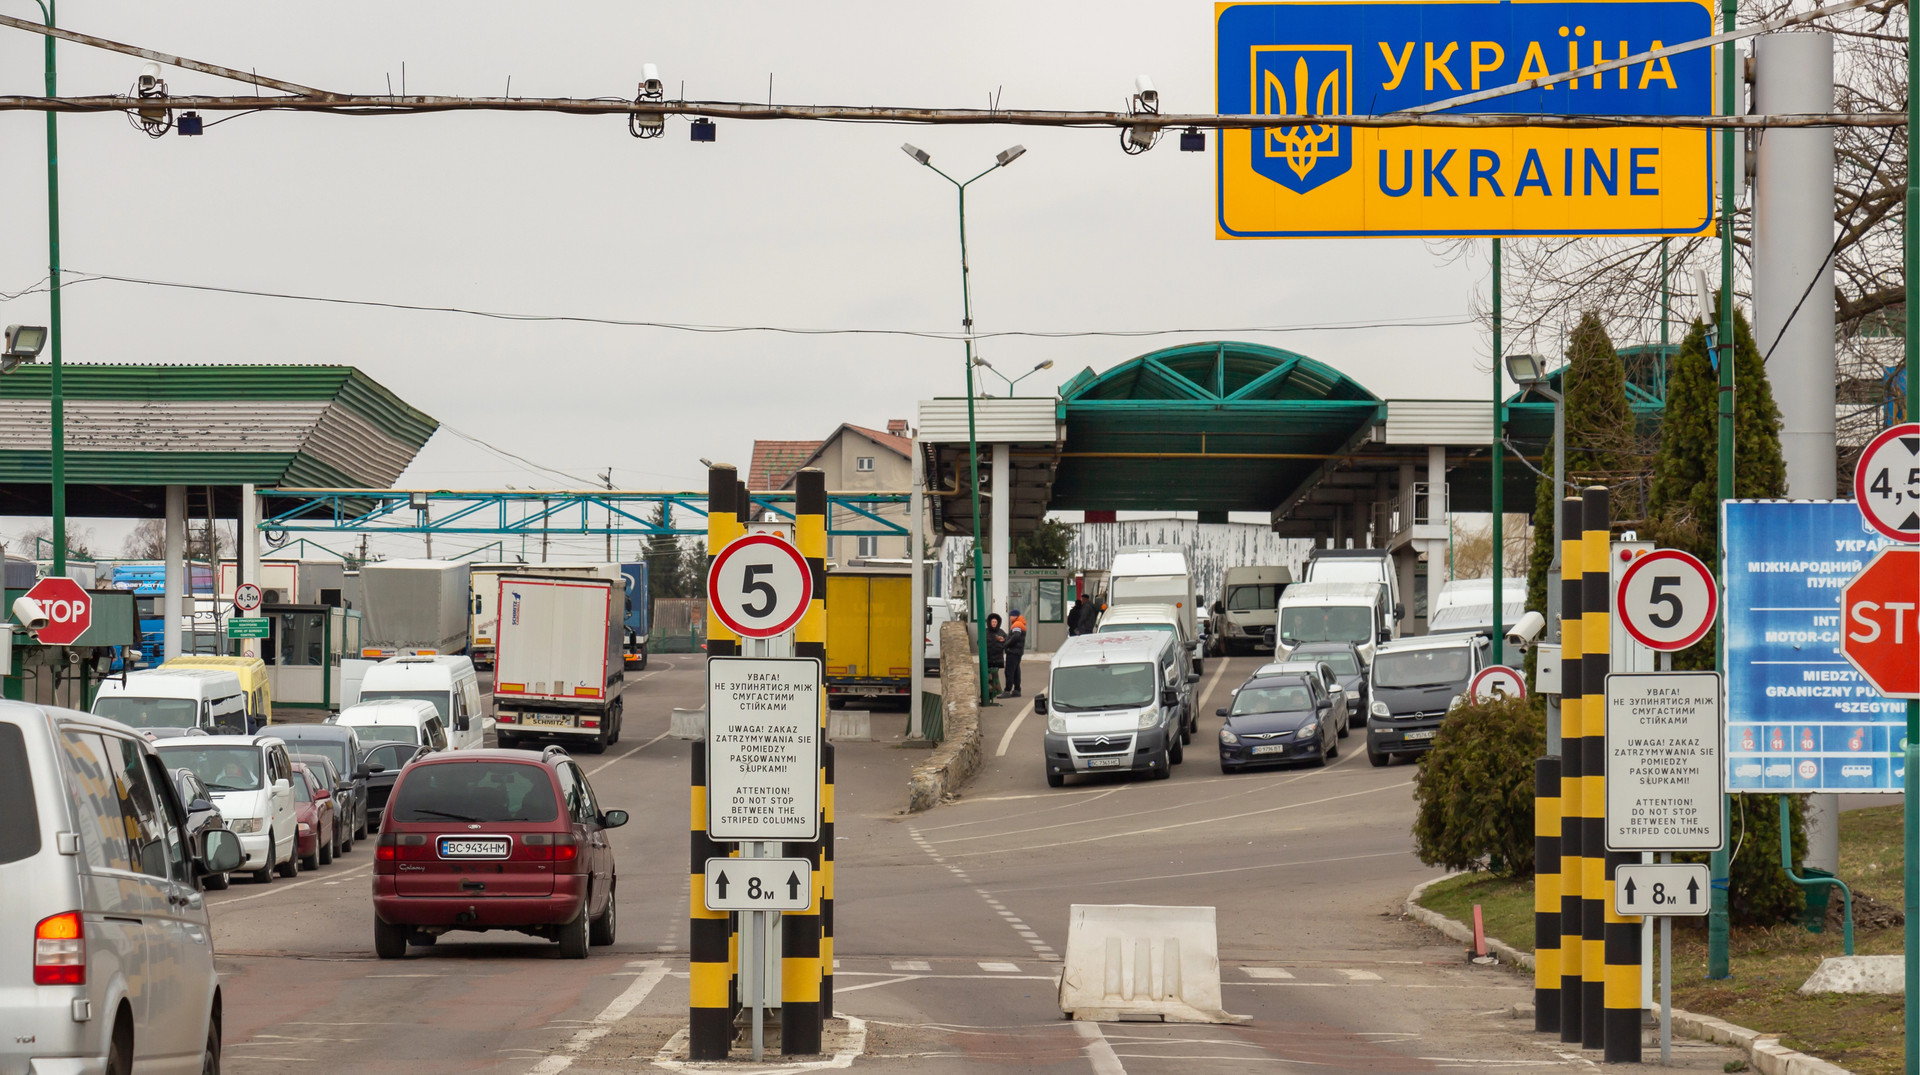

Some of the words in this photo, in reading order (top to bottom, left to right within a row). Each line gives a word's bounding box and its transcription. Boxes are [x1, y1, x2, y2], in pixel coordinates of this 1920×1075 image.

[1378, 26, 1678, 91] УКРАЇНА
[1379, 148, 1659, 197] UKRAINE
[1835, 537, 1905, 552] УКРАЇ
[1748, 560, 1862, 574] МІЖНАРОДНИЙ
[1807, 577, 1849, 588] ПУНК
[741, 564, 777, 618] 5
[1648, 576, 1683, 628] 5
[1849, 601, 1920, 644] ST
[1765, 631, 1840, 642] MOTOR-CA
[1803, 670, 1864, 681] MIEDZY
[730, 683, 789, 691] ЗУПИНЯТИСЯ
[1766, 686, 1852, 697] GRANICZNY
[1856, 686, 1880, 697] PU
[740, 702, 786, 710] СТІЙКАМИ
[1835, 702, 1907, 713] “SZEGYNI
[1640, 716, 1687, 724] СТІЙКАМИ
[716, 735, 793, 743] ZATRZYMYWANIA
[1742, 740, 1753, 748] 12
[1773, 740, 1782, 748] 11
[1802, 740, 1813, 748] 10
[1852, 740, 1859, 748] 5
[741, 745, 785, 753] POMIEDZY
[740, 765, 787, 773] SŁUPKAMI!
